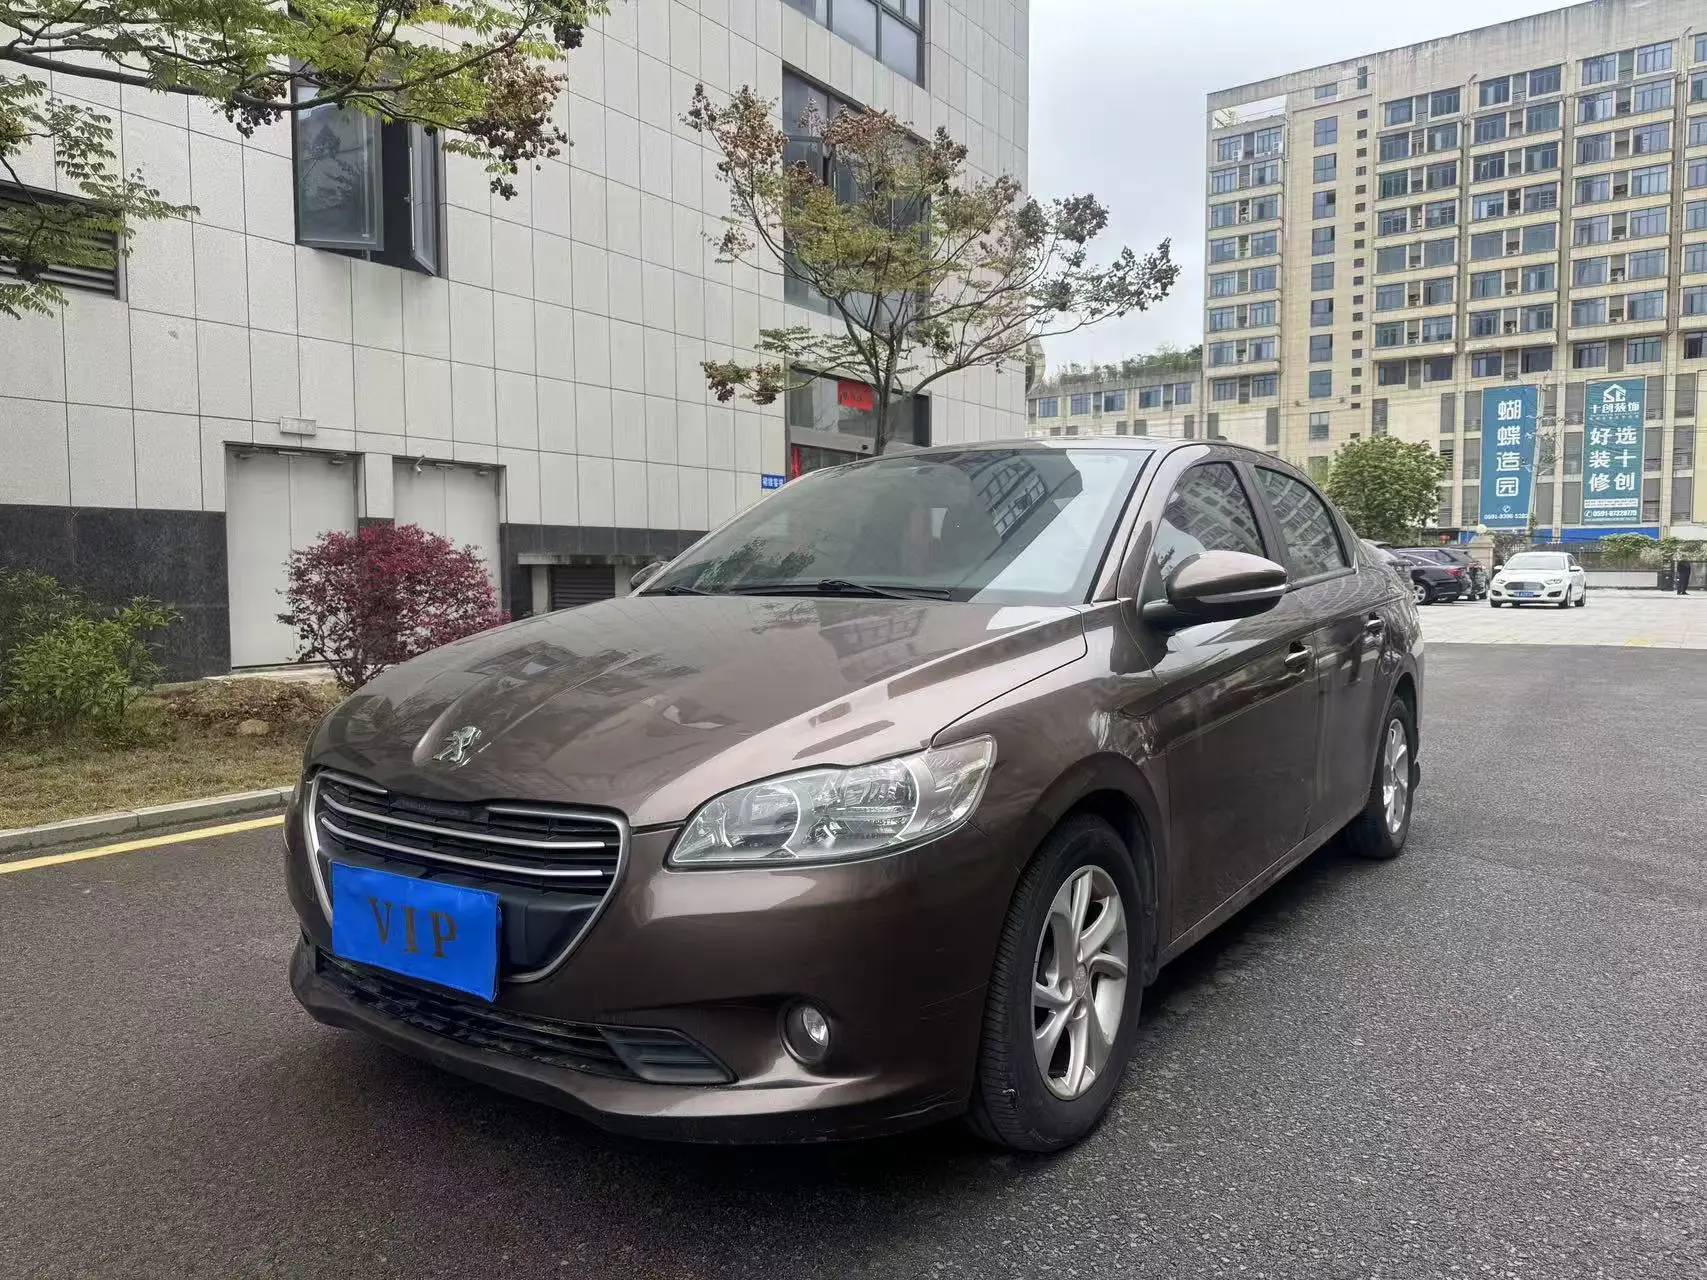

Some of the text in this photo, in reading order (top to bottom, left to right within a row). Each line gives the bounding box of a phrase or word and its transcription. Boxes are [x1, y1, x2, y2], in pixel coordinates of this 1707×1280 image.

[1496, 399, 1521, 497] 蝴蝶造园
[1589, 427, 1612, 492] 好装修
[1614, 425, 1637, 491] 选十创
[368, 897, 457, 960] VIP
